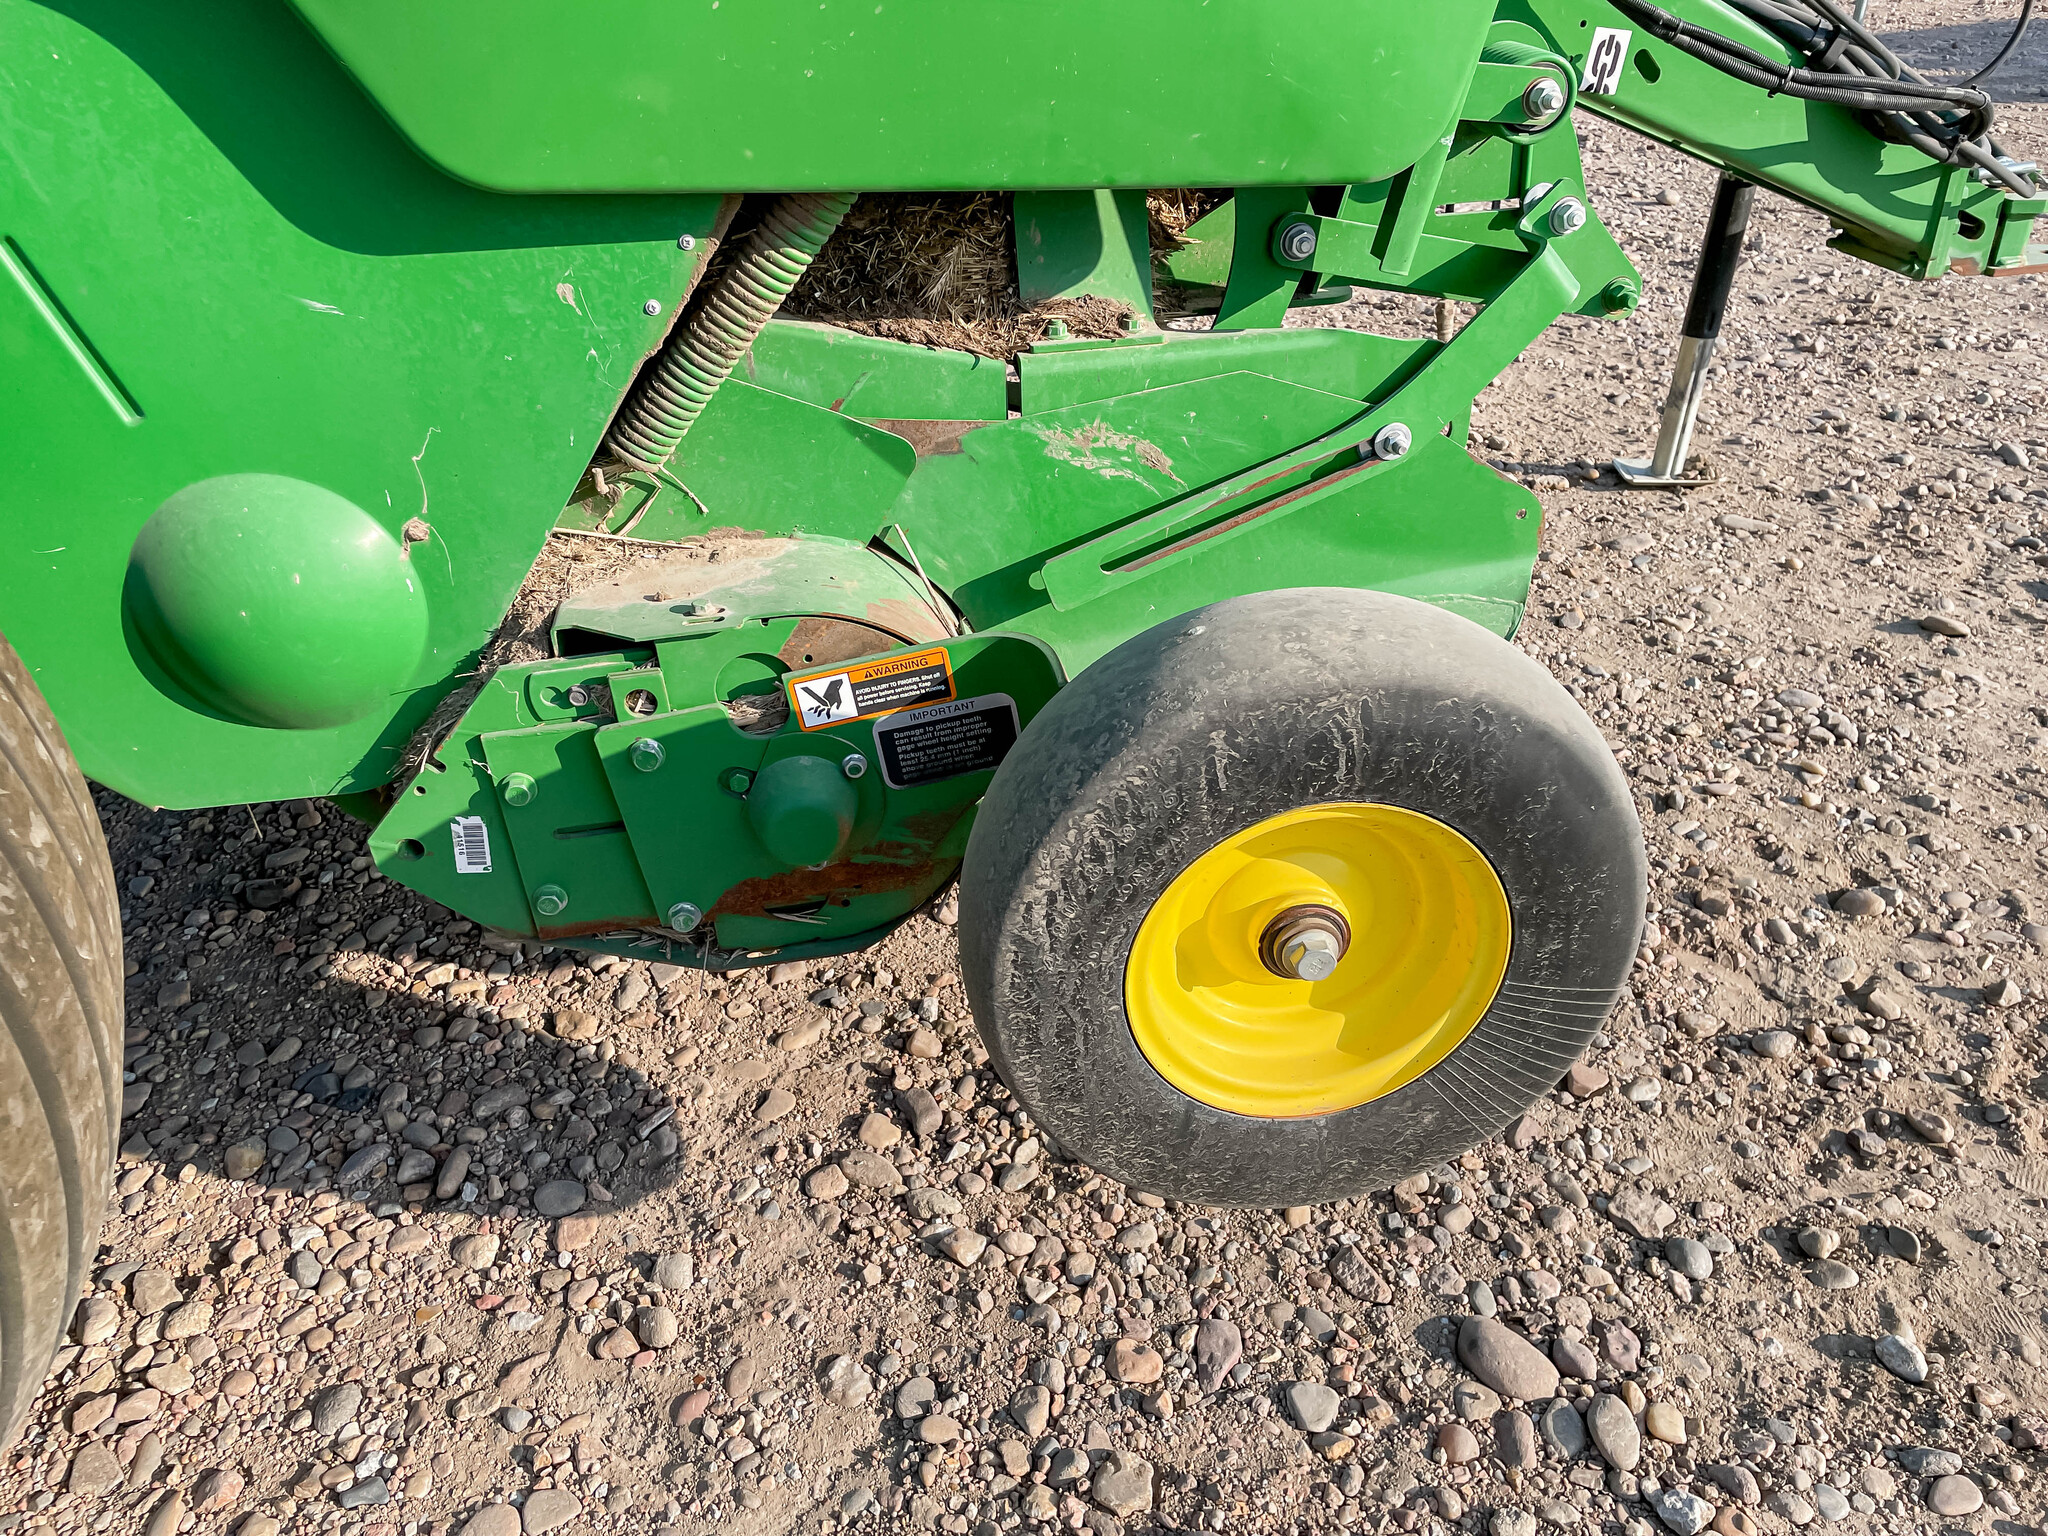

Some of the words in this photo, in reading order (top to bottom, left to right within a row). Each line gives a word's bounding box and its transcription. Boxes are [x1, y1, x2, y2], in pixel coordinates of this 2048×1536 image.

[872, 657, 928, 676] WARNING
[856, 686, 871, 696] AVOID
[871, 683, 890, 692] INJURY
[864, 692, 879, 702] power
[879, 689, 894, 697] before
[900, 690, 920, 698] machine
[910, 701, 975, 721] IMPORTANT
[894, 728, 924, 739] Damage
[936, 720, 960, 731] pickup
[962, 715, 982, 724] teeth
[911, 732, 933, 742] result
[954, 722, 987, 732] improper
[897, 743, 915, 753] gage
[917, 738, 939, 747] wheel
[940, 732, 964, 743] height
[966, 728, 992, 737] setting
[899, 751, 924, 761] Pickup
[926, 746, 945, 755] teeth
[900, 758, 918, 767] least
[920, 754, 935, 762] 25.4
[962, 745, 981, 753] inch)
[902, 764, 924, 773] above
[926, 757, 953, 767] ground
